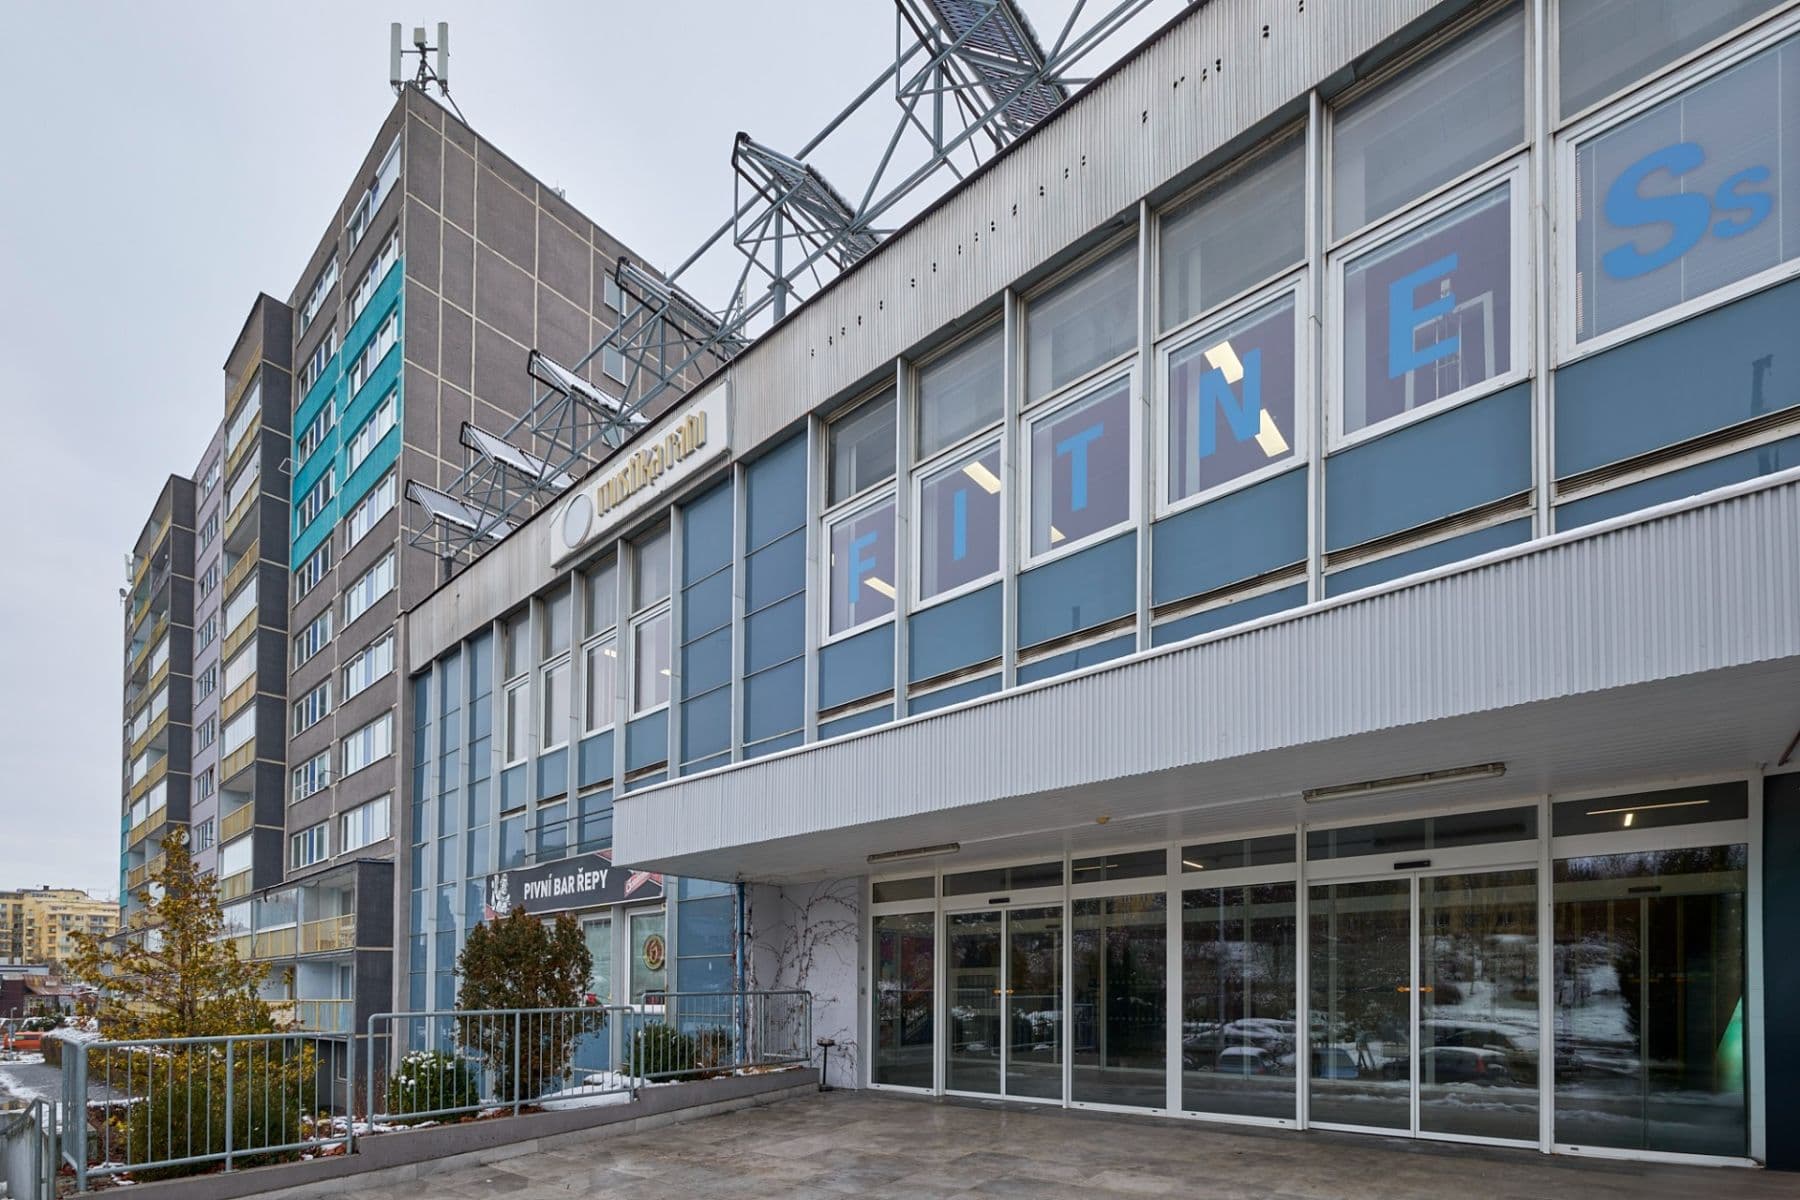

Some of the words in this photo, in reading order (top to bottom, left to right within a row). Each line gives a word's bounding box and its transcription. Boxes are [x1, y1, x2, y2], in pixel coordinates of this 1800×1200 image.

[523, 873, 552, 900] PIVNÍ
[553, 875, 575, 896] BAR
[577, 867, 608, 892] ŘEPY
